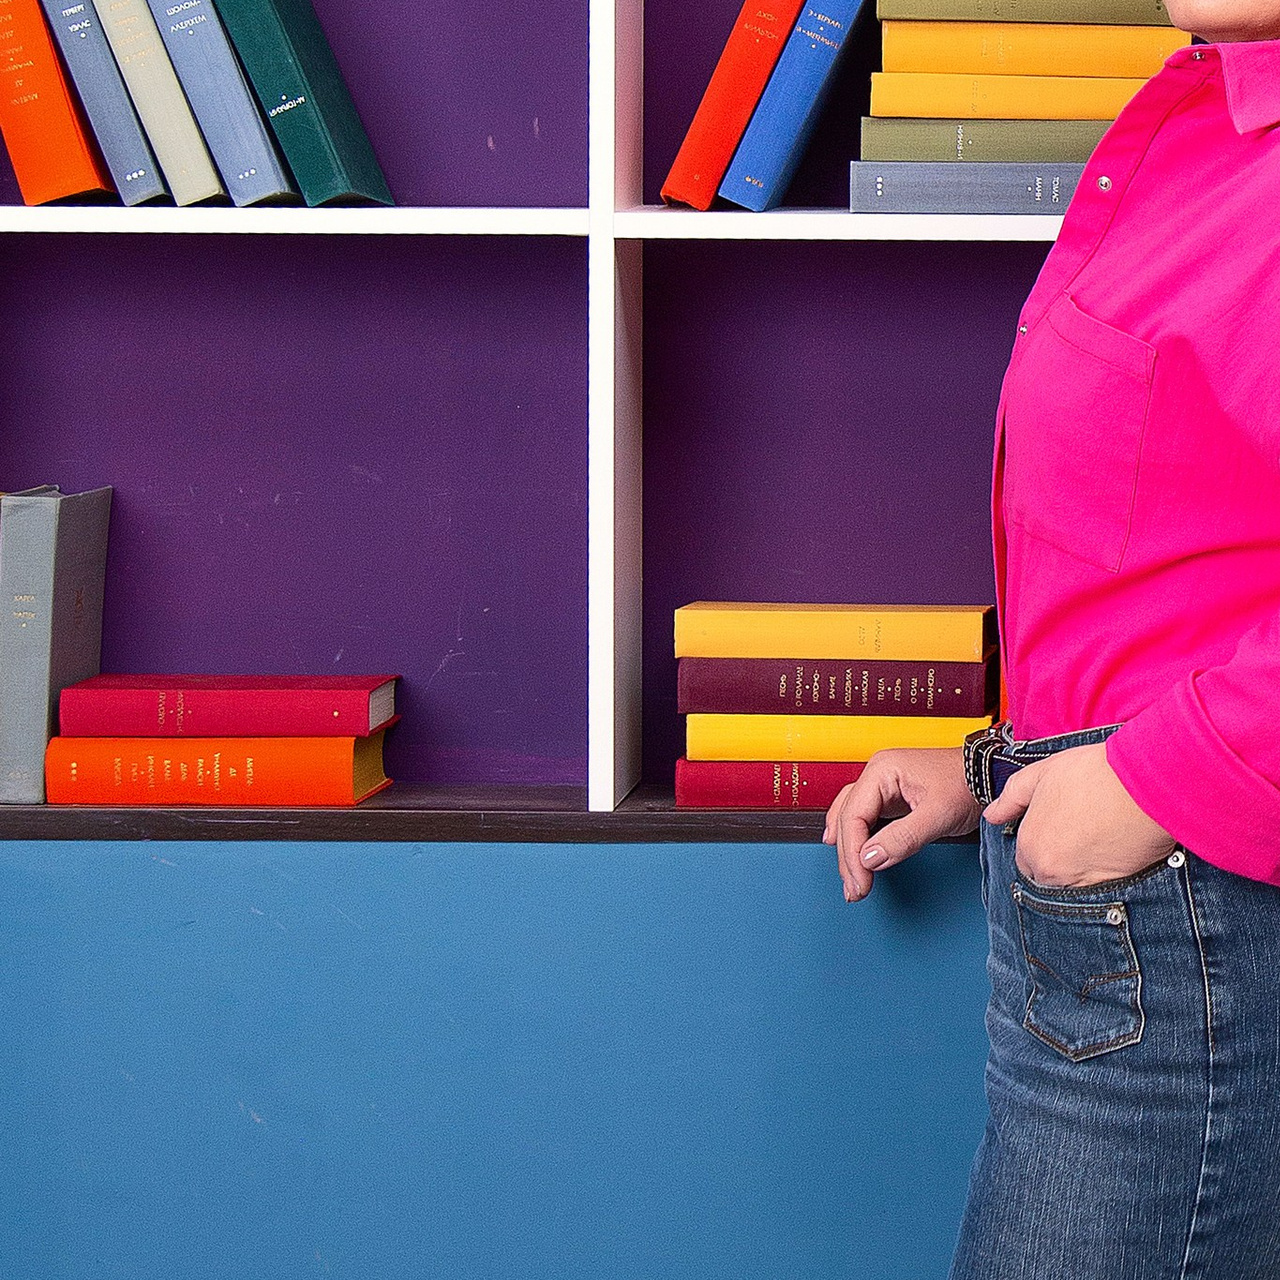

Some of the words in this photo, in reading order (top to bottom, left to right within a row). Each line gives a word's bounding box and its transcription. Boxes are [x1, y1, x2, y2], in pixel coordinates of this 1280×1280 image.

[61, 3, 86, 18] ГЕРБЕРТ
[67, 18, 92, 33] УЭЛЛС
[169, 14, 207, 34] АЛЕЙХЕМ
[1034, 175, 1043, 202] МАНН
[1051, 175, 1060, 204] ТОМАС
[779, 673, 787, 698] ПЕСНЬ
[795, 666, 803, 698] РОЛАНДЕ
[861, 670, 869, 706] НИМСКАЯ
